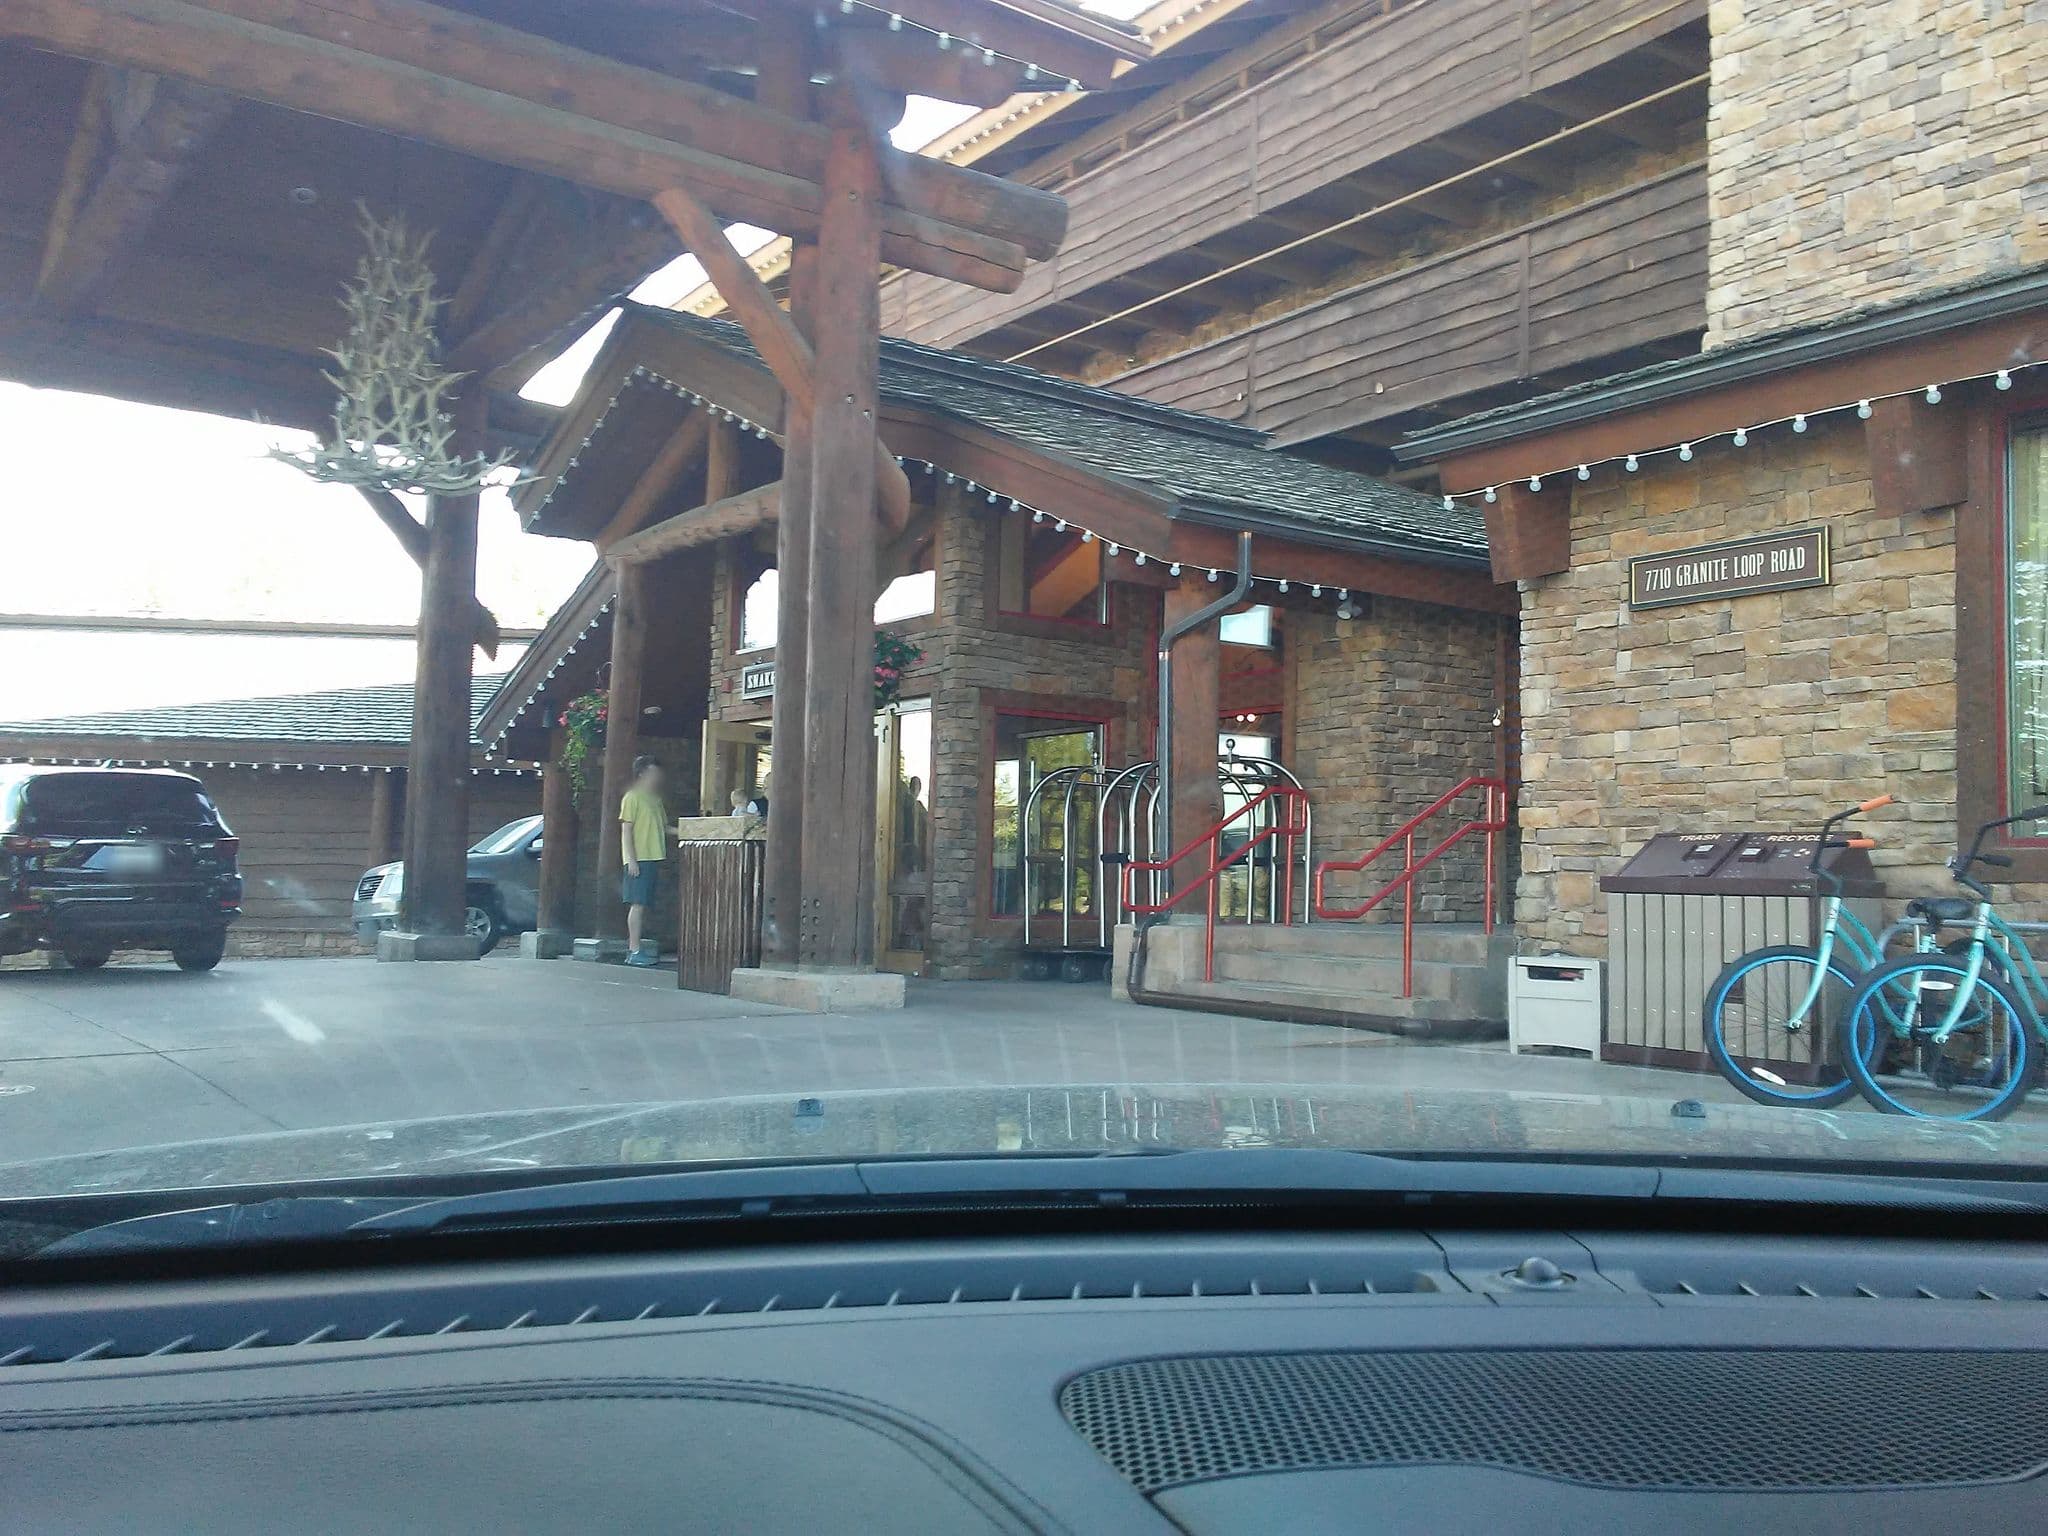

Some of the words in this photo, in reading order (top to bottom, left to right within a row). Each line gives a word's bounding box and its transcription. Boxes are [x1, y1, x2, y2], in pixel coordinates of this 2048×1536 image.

[1645, 565, 1671, 592] 7710
[1676, 559, 1728, 586] GRANITE
[1734, 553, 1764, 579] LOOP
[1771, 547, 1805, 573] ROAD
[1679, 834, 1722, 842] TRASH
[1766, 834, 1834, 842] RECYCLE
